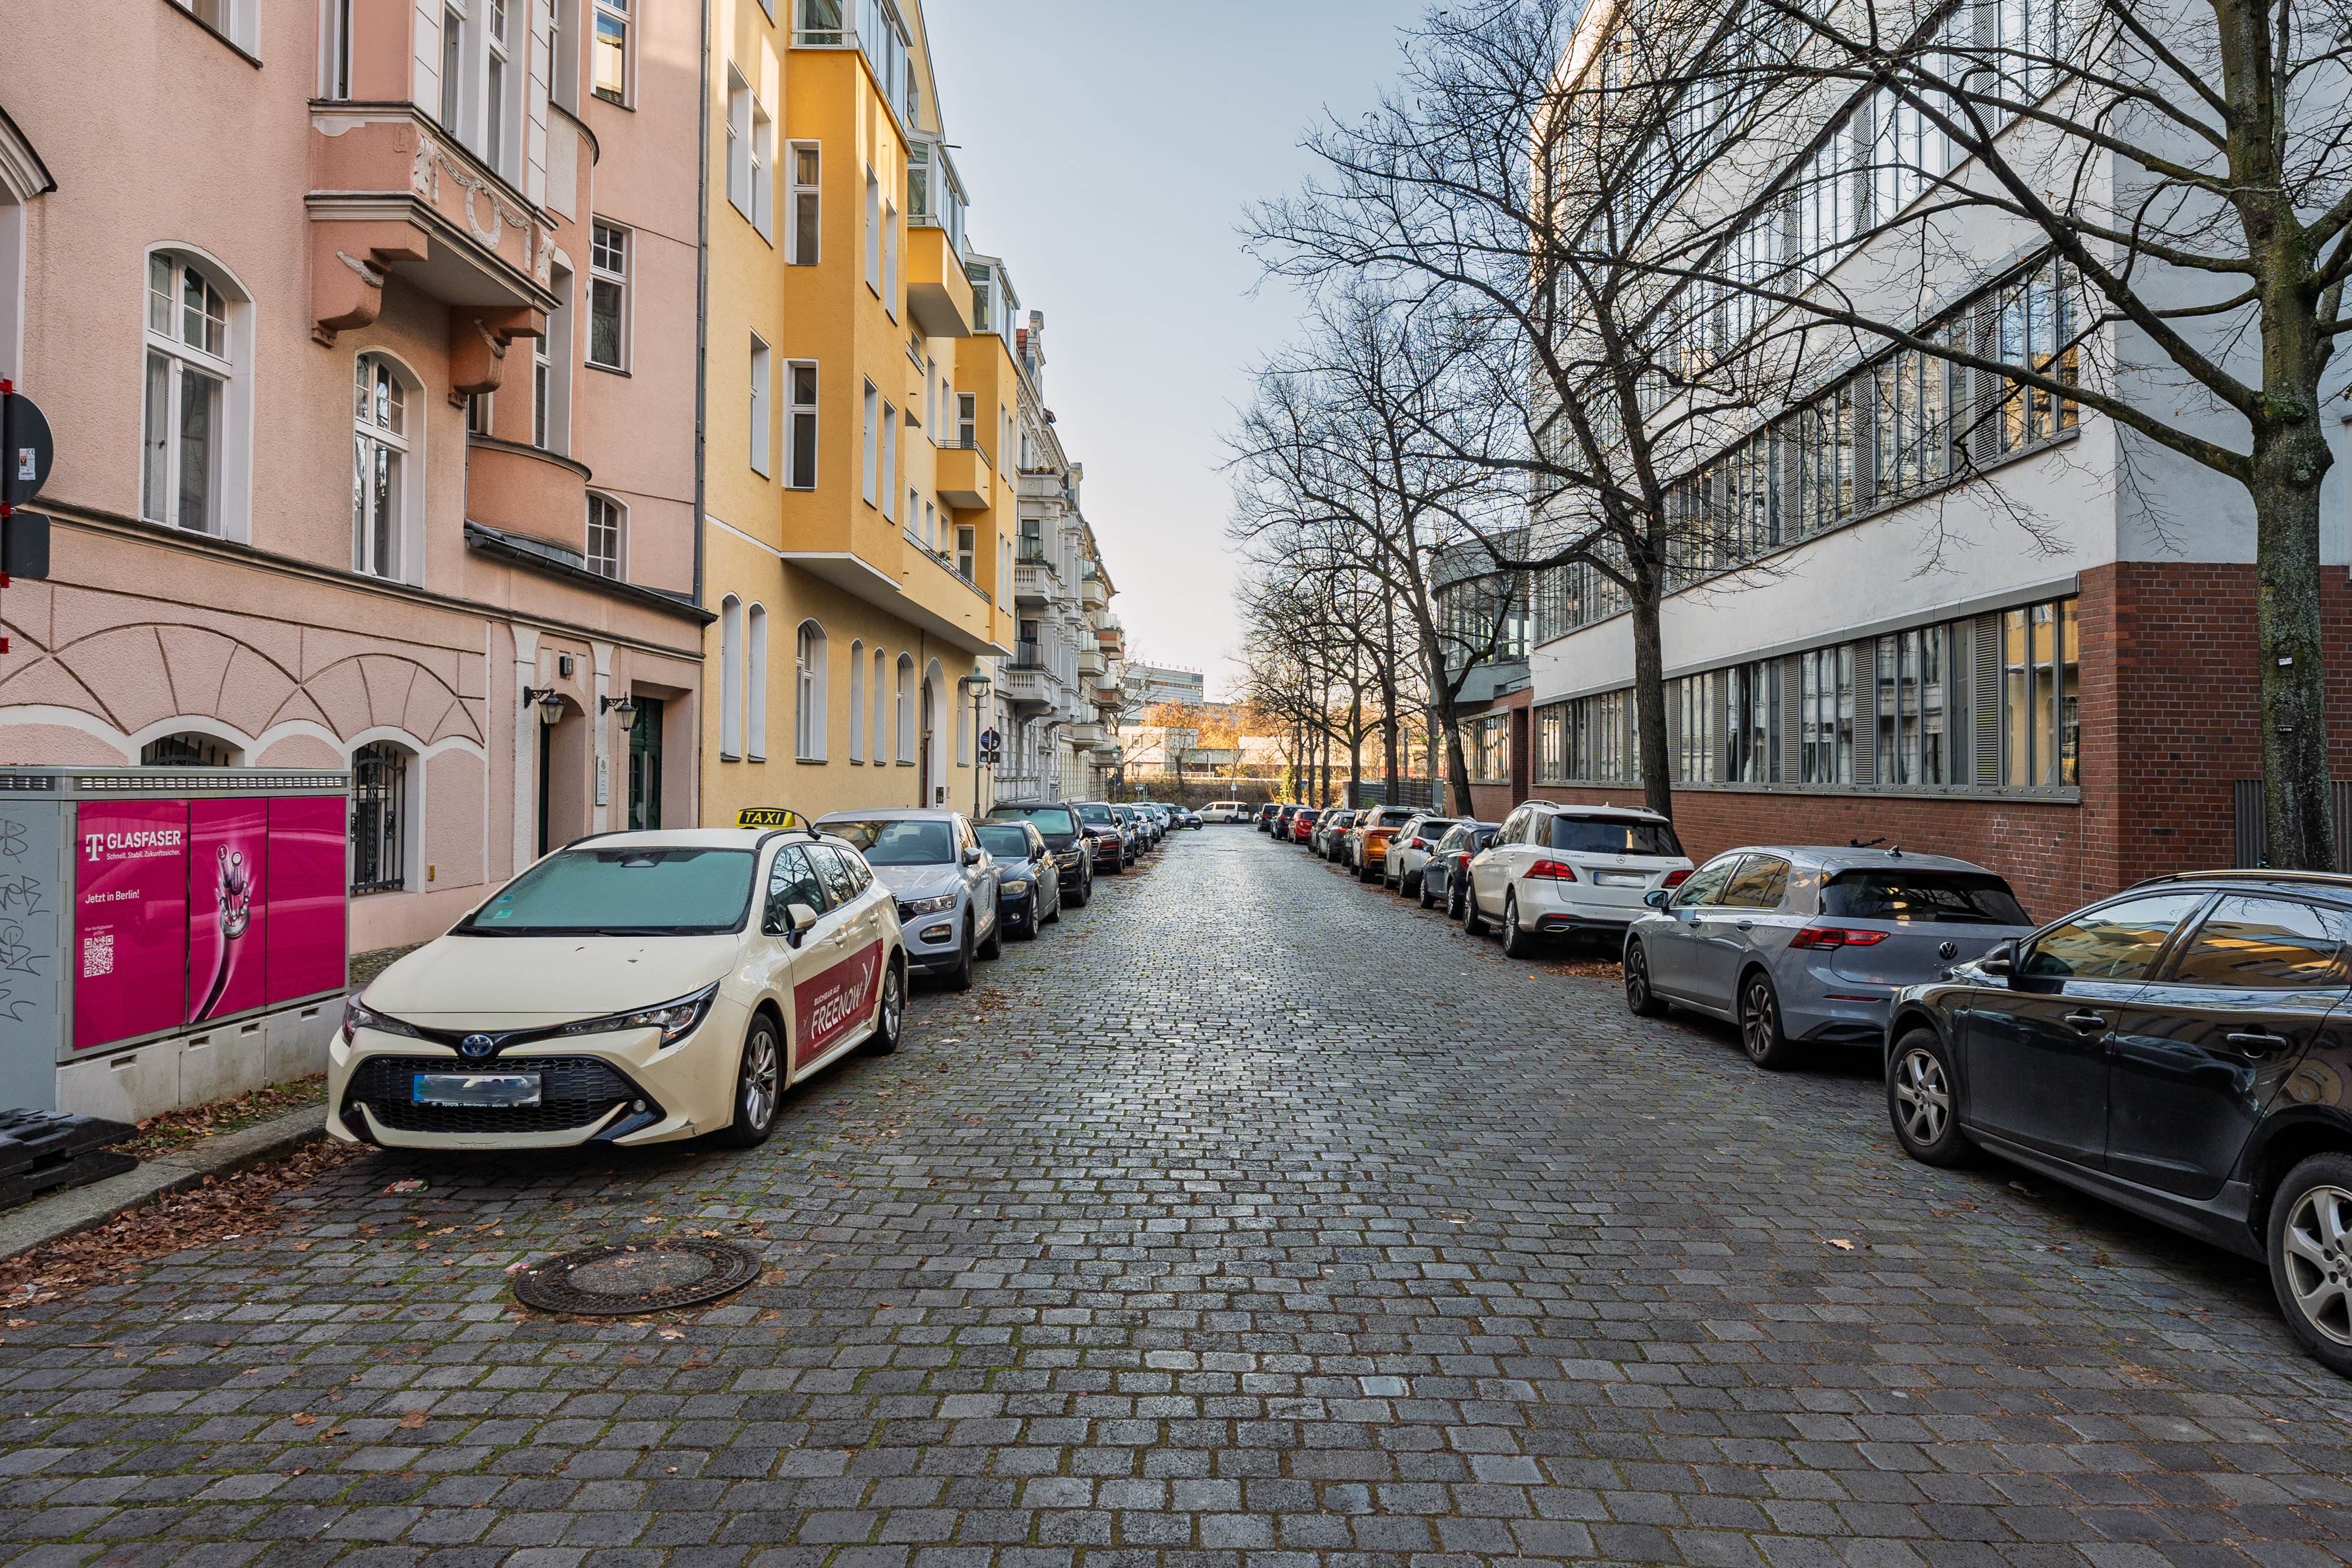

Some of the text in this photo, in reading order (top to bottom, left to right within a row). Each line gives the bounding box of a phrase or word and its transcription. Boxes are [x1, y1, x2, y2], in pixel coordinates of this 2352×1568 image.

[745, 812, 781, 824] TAXI
[106, 830, 181, 850] GLASFASER
[144, 849, 181, 858] Zukunftssicher.
[85, 889, 139, 904] Jetzt in Berlin!
[814, 984, 841, 1006] BUCHBAR AUF
[811, 981, 863, 1039] FREENOW
